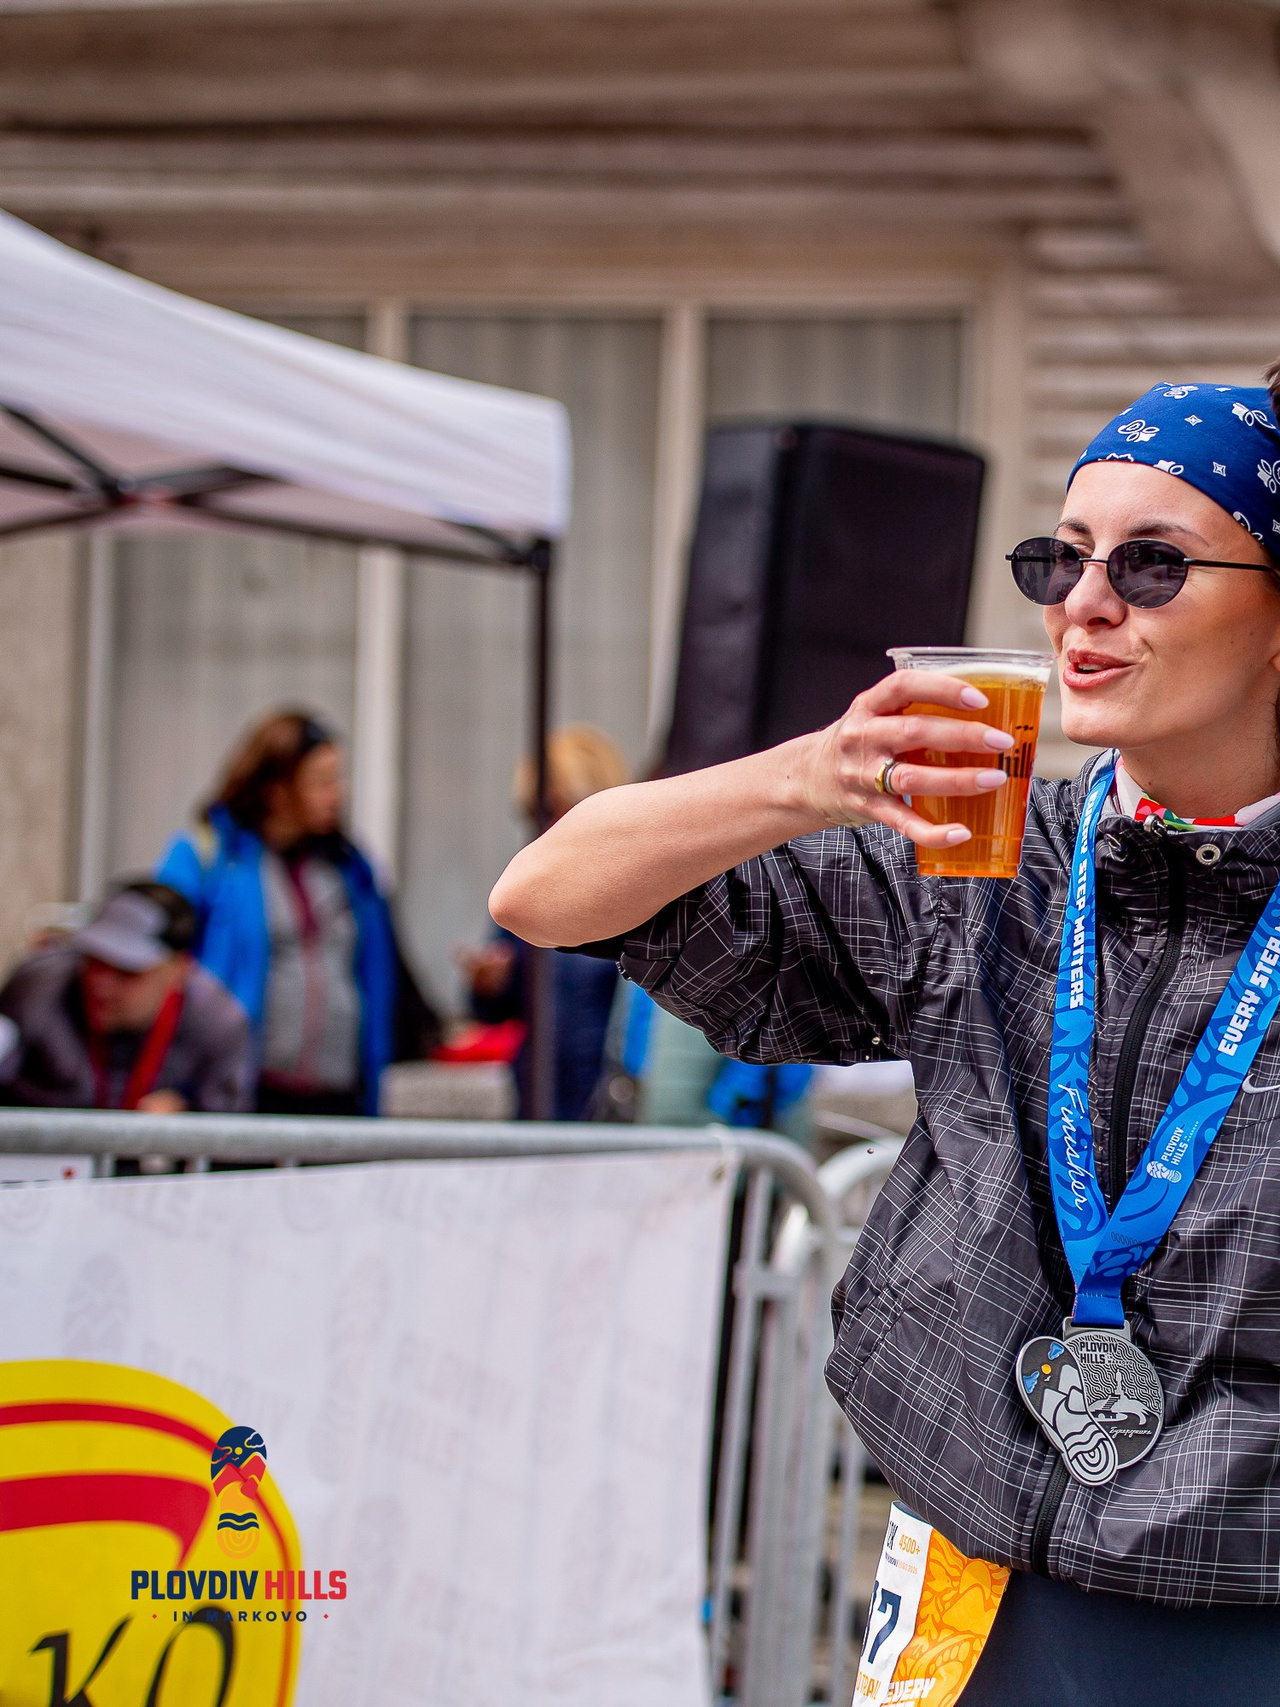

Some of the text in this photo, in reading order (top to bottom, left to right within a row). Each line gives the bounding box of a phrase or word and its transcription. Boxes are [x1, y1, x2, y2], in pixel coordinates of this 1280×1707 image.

[1069, 789, 1099, 1010] EVERY STEP MATTERS
[1217, 988, 1261, 1057] EVERY
[1057, 1084, 1095, 1211] Finisher
[1161, 1126, 1184, 1162] PLOVDIV
[1170, 1141, 1189, 1166] HILLS
[1079, 1341, 1118, 1353] PLOVDIV
[1080, 1353, 1105, 1364] HILLS
[887, 1677, 937, 1703] EVERY
